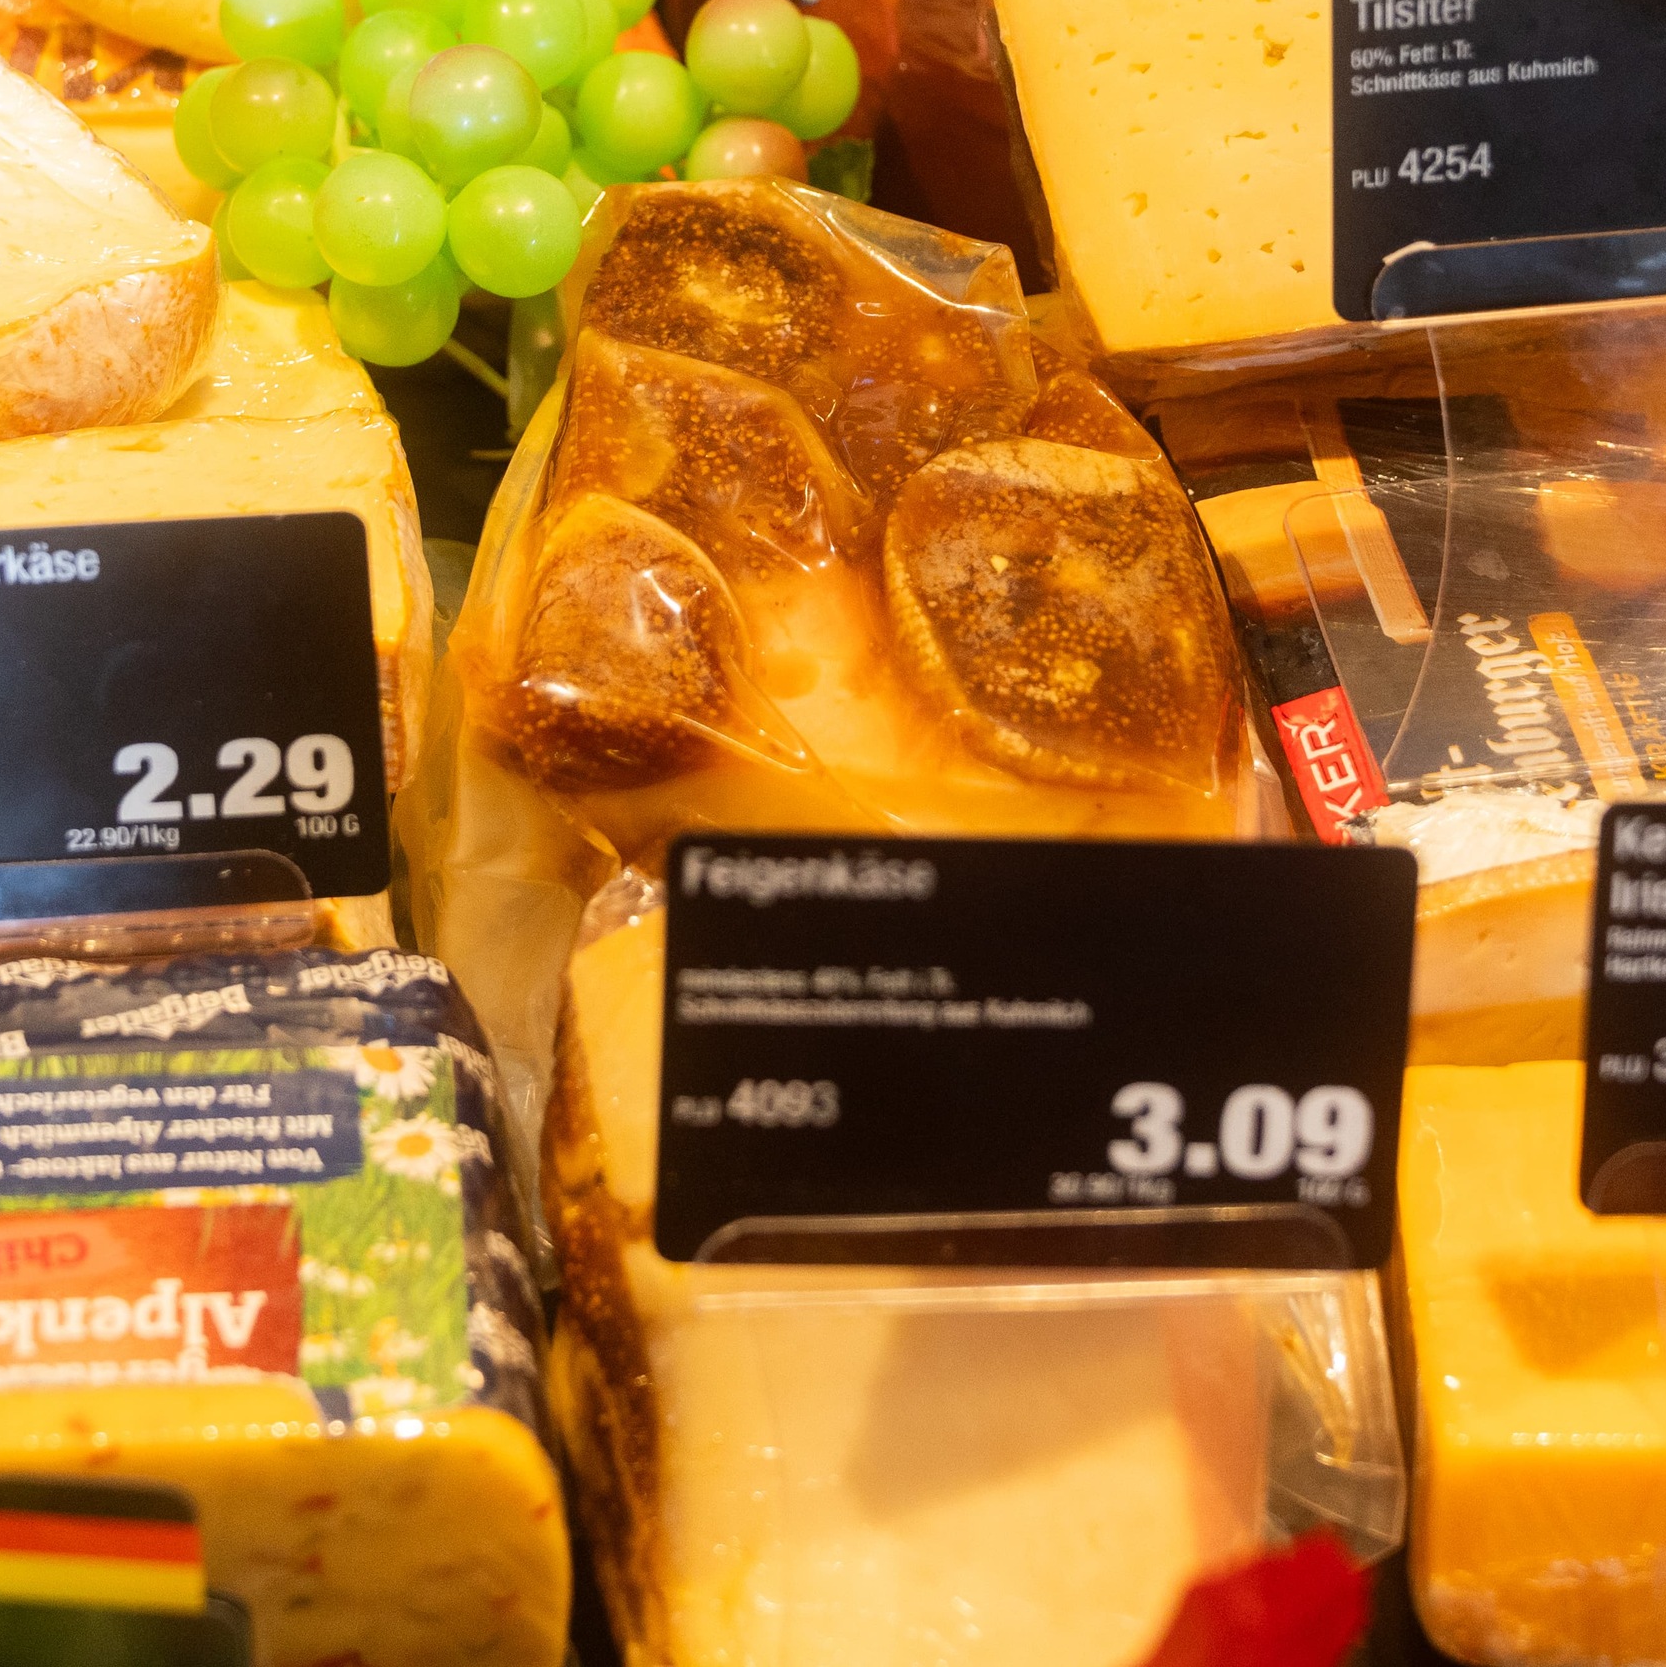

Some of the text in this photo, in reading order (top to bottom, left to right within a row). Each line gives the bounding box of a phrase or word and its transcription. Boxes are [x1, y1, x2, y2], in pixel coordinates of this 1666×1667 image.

[1350, 46, 1394, 71] 60%
[1398, 42, 1437, 66] Fett
[1350, 53, 1599, 98] Schnittkäse aus Kuhmilch
[1351, 140, 1494, 191] PLU 4254
[113, 734, 355, 825] 2.29
[66, 813, 361, 853] 22.90/1kg 100 G
[681, 847, 936, 906] Feigenkäse
[299, 949, 449, 995] Bergader
[81, 983, 252, 1039] Bergader
[162, 1085, 215, 1110] den
[217, 1083, 271, 1108] Für
[726, 1078, 841, 1129] 4093
[0, 1119, 162, 1149] Alpenmilch
[169, 1115, 290, 1142] frischer
[291, 1113, 333, 1139] Mit
[1107, 1081, 1375, 1180] 3.09
[126, 1151, 179, 1175] aus
[181, 1148, 264, 1175] Natur
[266, 1145, 324, 1173] Von
